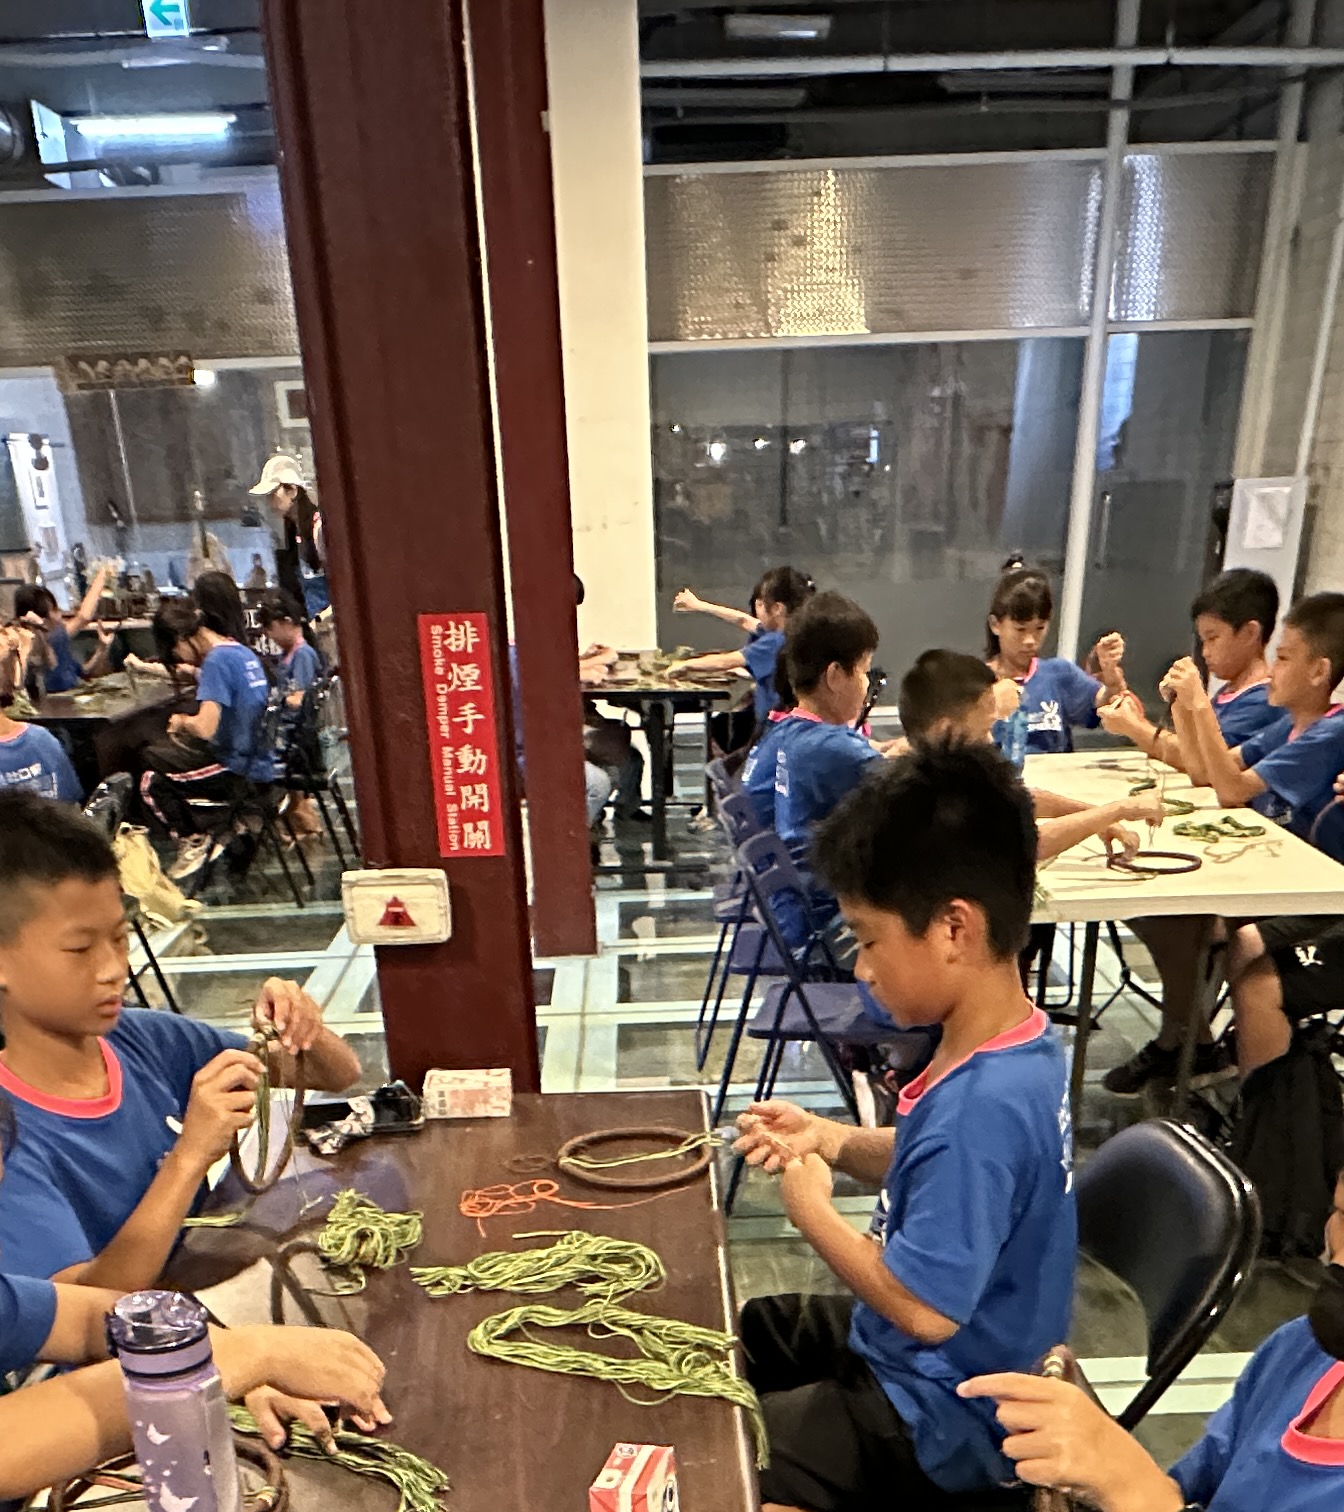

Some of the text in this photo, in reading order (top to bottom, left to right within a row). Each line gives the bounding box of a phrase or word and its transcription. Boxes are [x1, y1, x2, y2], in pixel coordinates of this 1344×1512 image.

[430, 624, 445, 676] Smoke
[435, 683, 452, 739] Damper
[443, 620, 492, 850] 排煙手動開關
[441, 746, 456, 796] Manual
